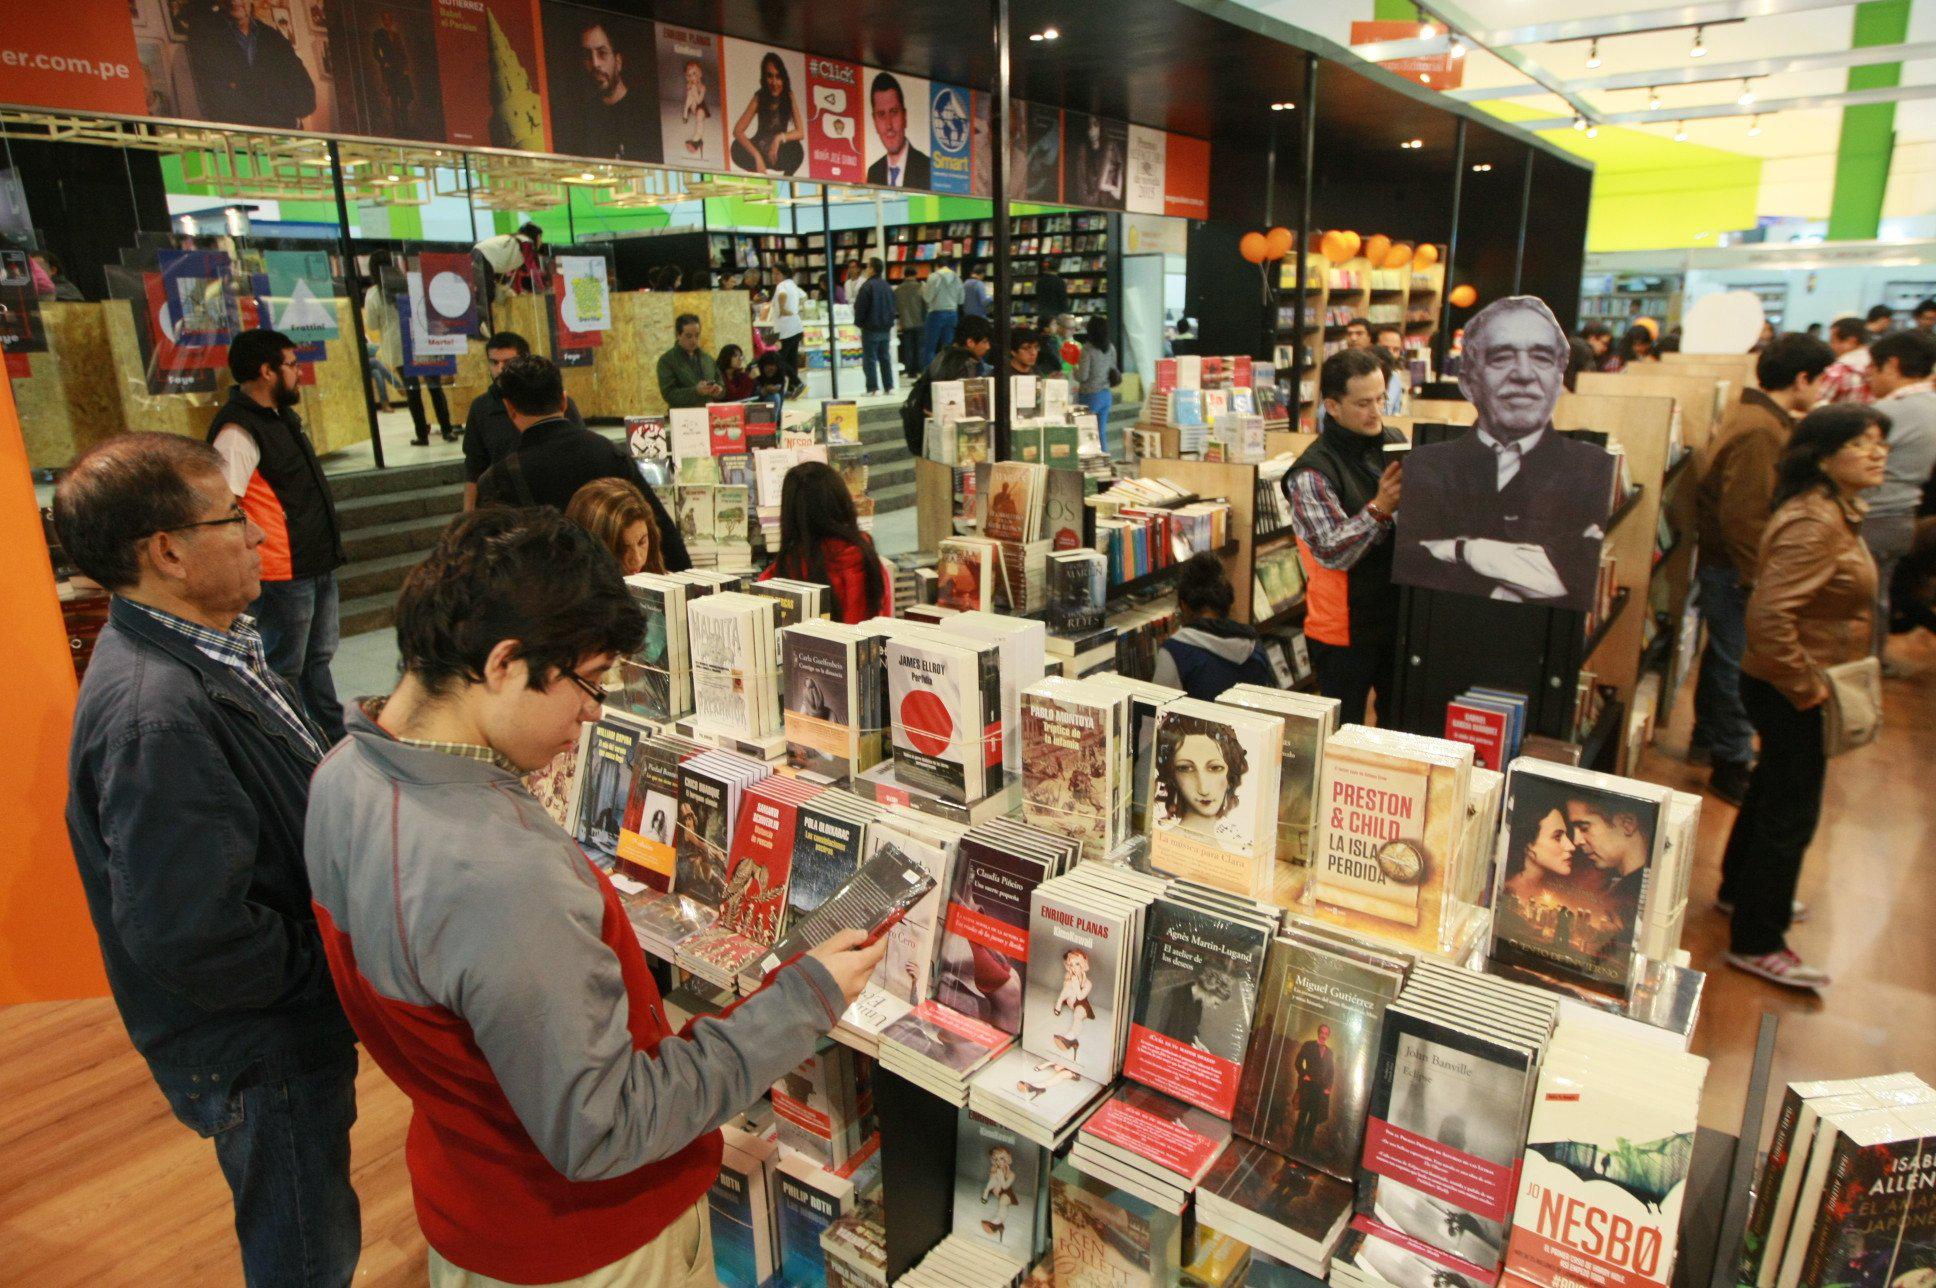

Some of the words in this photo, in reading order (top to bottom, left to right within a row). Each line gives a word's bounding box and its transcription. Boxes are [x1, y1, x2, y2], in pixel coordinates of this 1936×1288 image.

[809, 60, 855, 84] #Click
[932, 151, 969, 172] Smart
[898, 654, 921, 670] JAMES
[921, 657, 946, 676] ELLROY
[1030, 704, 1054, 720] PABLO
[1055, 709, 1095, 730] MONTOYA
[1333, 781, 1414, 820] PRESTON
[1330, 807, 1344, 831] &
[1349, 811, 1400, 843] CHILD
[1159, 832, 1168, 844] La
[1170, 839, 1200, 855] música
[1201, 848, 1220, 861] para
[1221, 853, 1246, 868] Clara
[1329, 833, 1345, 853] LA
[1349, 838, 1379, 862] ISLA
[976, 867, 1001, 884] Claudia
[1001, 874, 1025, 892] Piñeiro
[1328, 854, 1387, 886] PERDIDA
[1041, 905, 1075, 929] ENRIQUE
[1077, 919, 1110, 940] PLANAS
[897, 930, 918, 950] Cero
[1164, 943, 1172, 953] El
[1172, 948, 1194, 960] atelier
[1193, 954, 1203, 964] de
[1166, 926, 1190, 942] Agnès
[1191, 934, 1253, 963] Martin-Lugand
[1162, 952, 1172, 963] los
[1172, 956, 1194, 971] deseos
[1295, 974, 1329, 994] Miguel
[1330, 986, 1375, 1010] Gutiérrez
[1402, 1065, 1433, 1085] Eclipse
[1405, 1046, 1429, 1064] John
[1431, 1054, 1473, 1079] Banville
[720, 1173, 741, 1193] ROTH
[782, 1180, 808, 1204] PHILIP
[810, 1195, 832, 1217] ROTH
[1070, 1227, 1105, 1257] KEN
[1536, 1187, 1663, 1278] NESBØ
[1059, 1237, 1132, 1285] FOLLETT
